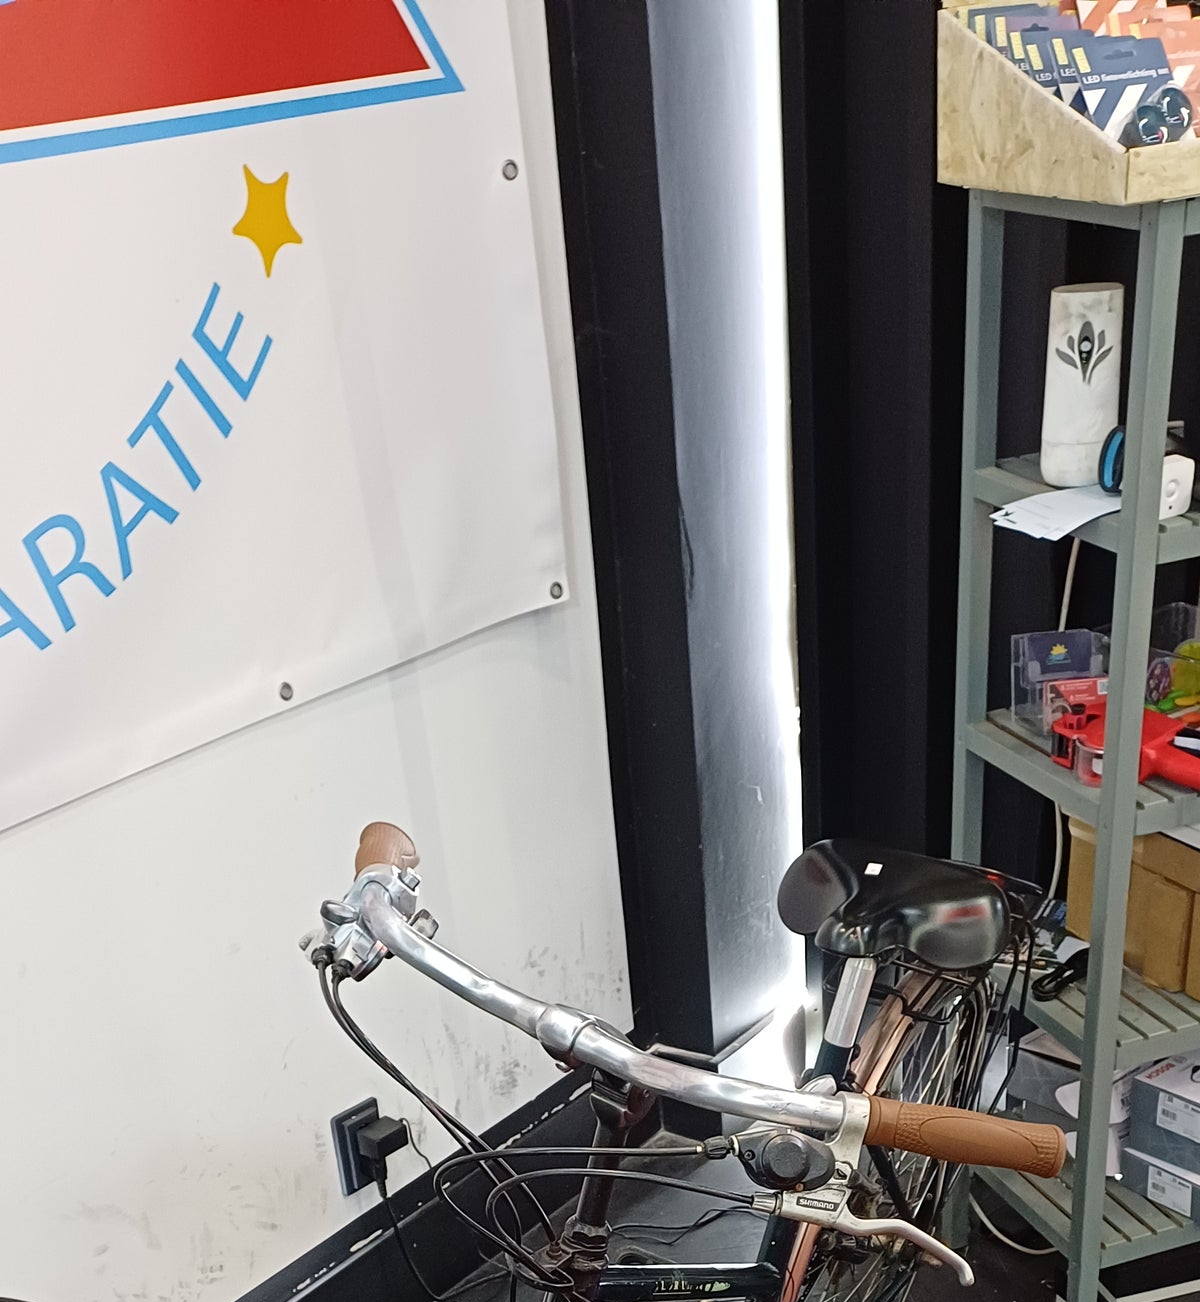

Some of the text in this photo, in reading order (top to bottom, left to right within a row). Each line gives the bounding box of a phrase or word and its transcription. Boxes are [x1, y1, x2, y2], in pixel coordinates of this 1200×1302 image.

[1034, 72, 1053, 82] LED
[1081, 74, 1101, 85] LED
[798, 1198, 836, 1211] SHIMANO
